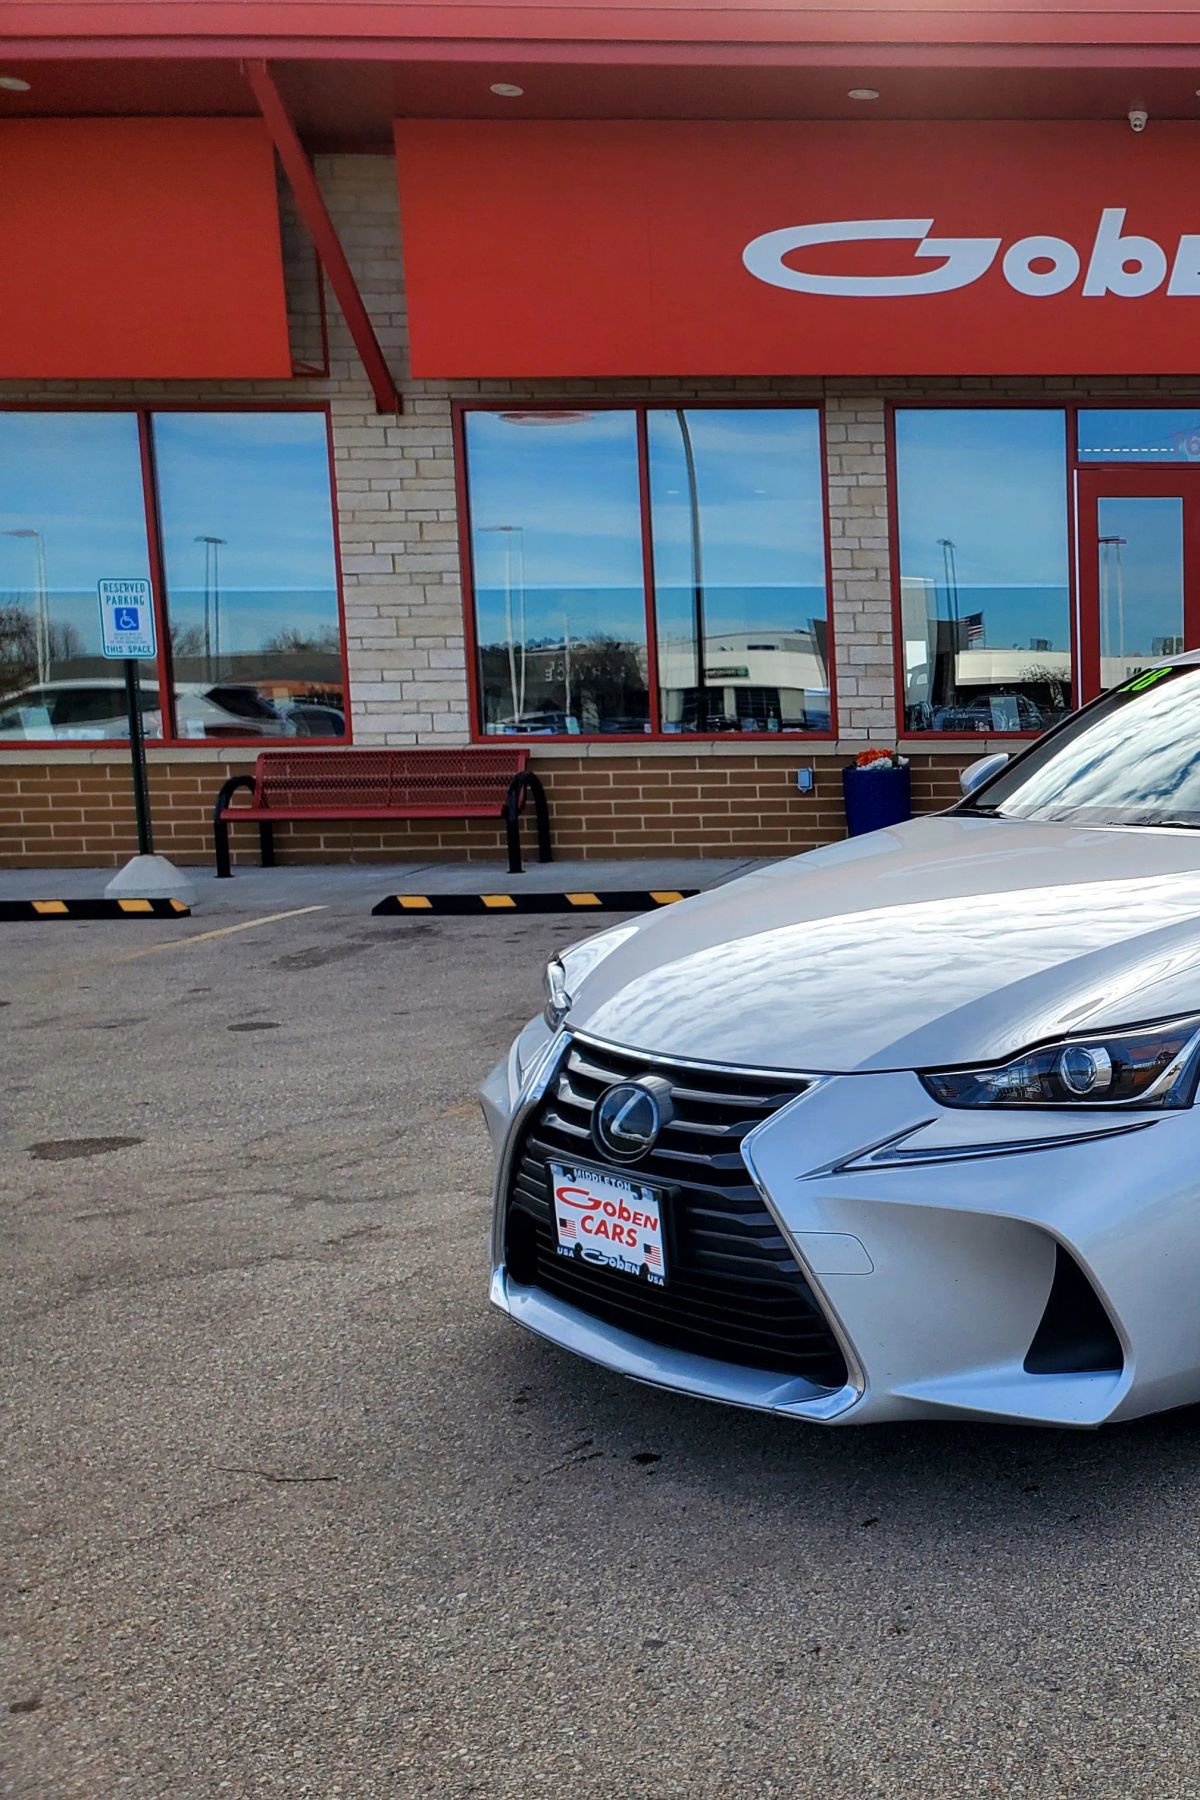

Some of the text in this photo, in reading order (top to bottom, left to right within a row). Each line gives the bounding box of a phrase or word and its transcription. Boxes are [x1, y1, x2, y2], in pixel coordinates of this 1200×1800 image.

[104, 582, 145, 593] RESERVED
[106, 595, 145, 606] PARKING
[107, 645, 151, 653] THIS SPACE
[1118, 667, 1173, 692] 18
[573, 1168, 632, 1190] MIDDLETON
[580, 1215, 637, 1248] CARS
[557, 1247, 575, 1257] USA
[647, 1274, 664, 1287] USA
